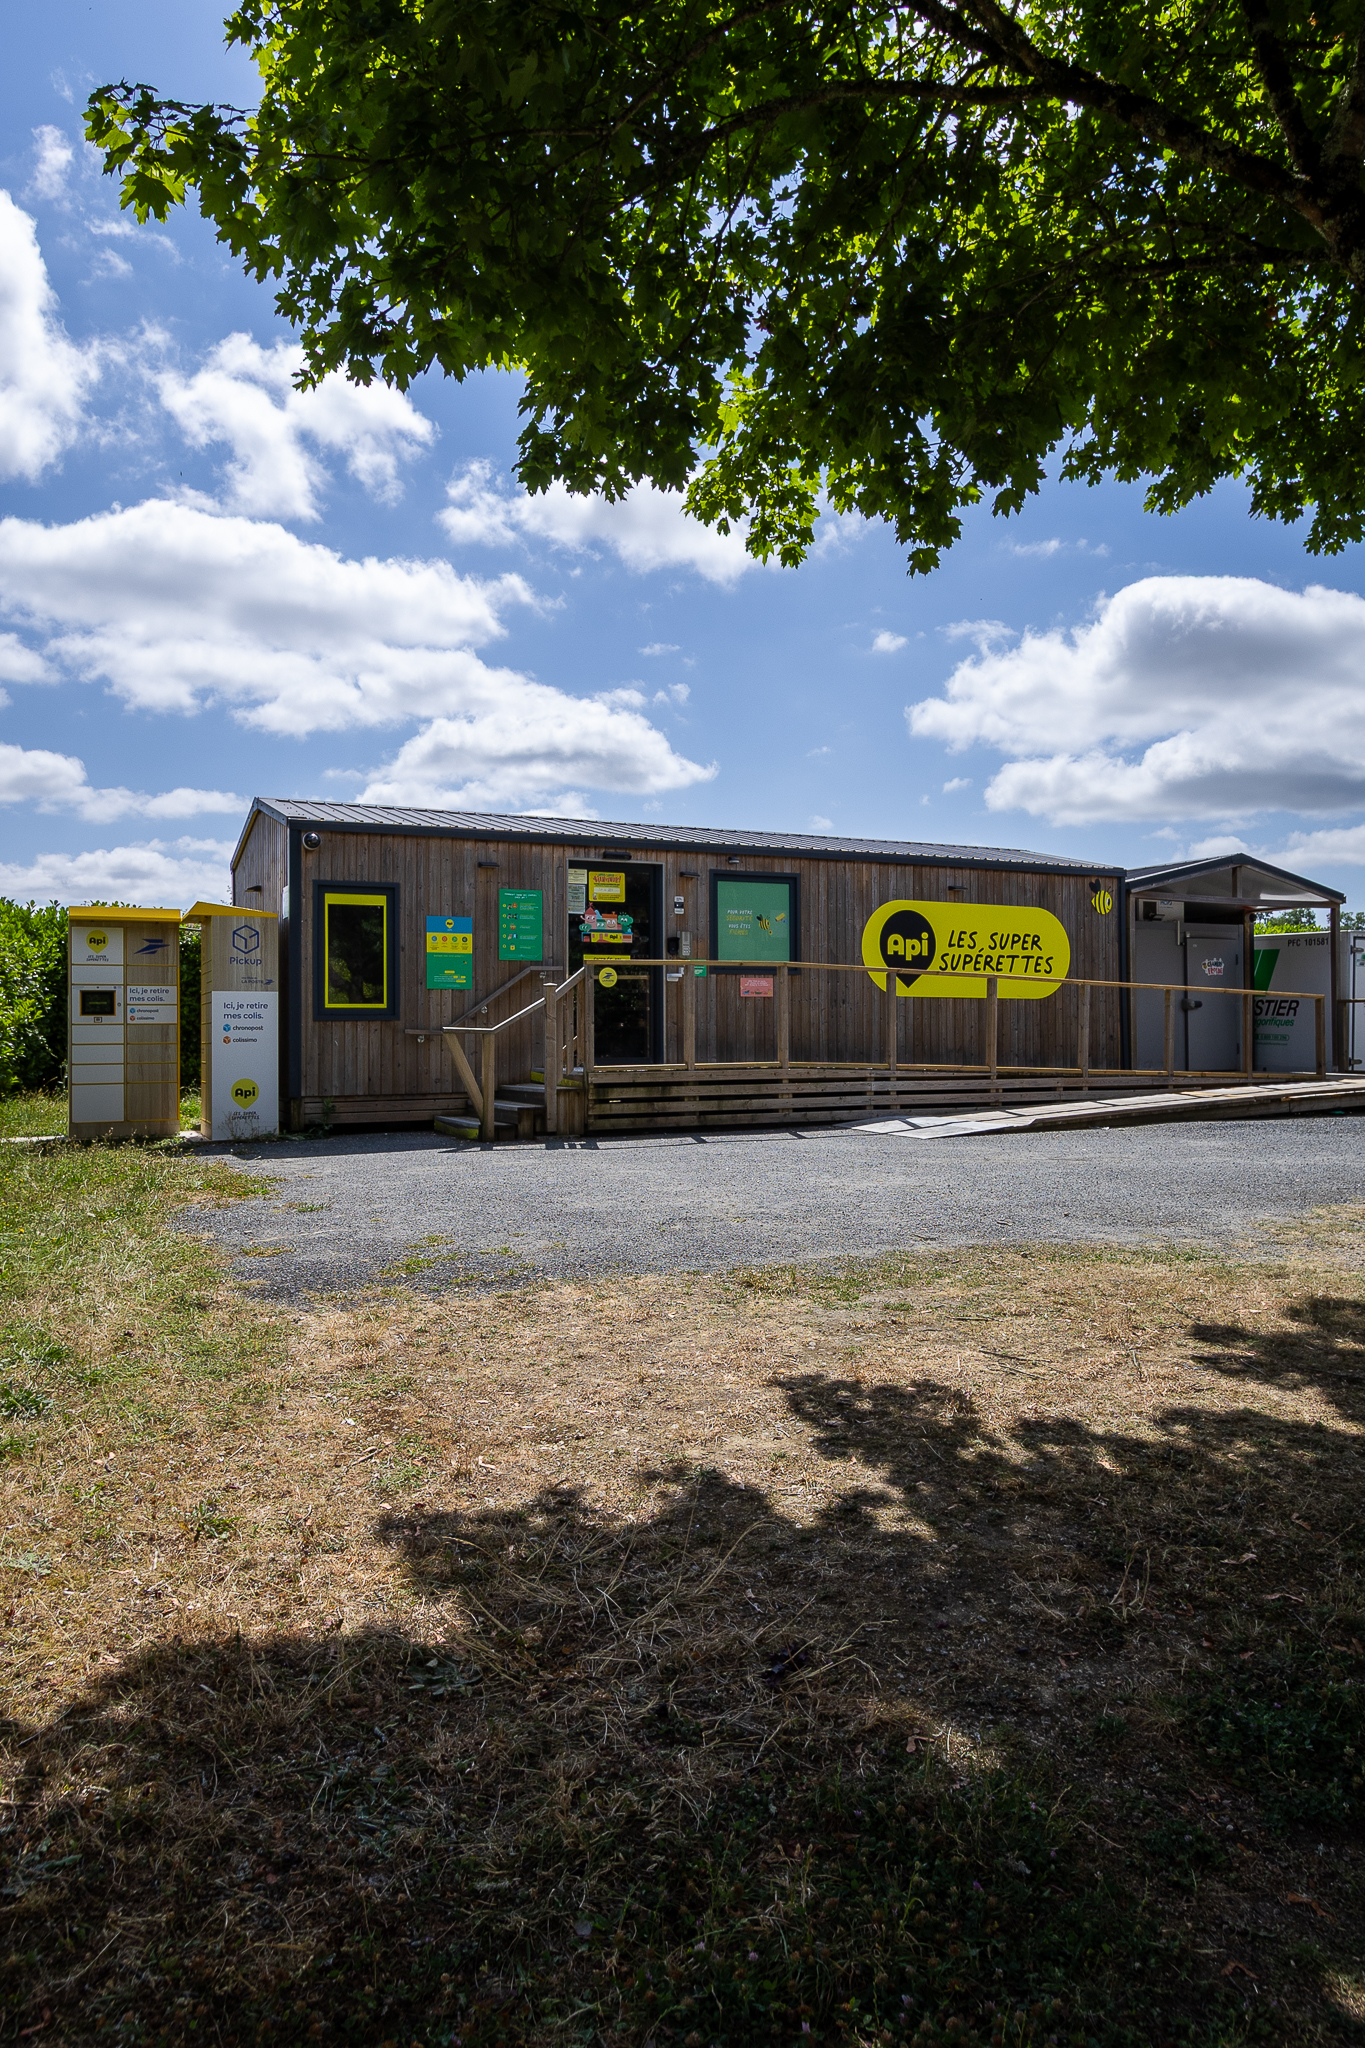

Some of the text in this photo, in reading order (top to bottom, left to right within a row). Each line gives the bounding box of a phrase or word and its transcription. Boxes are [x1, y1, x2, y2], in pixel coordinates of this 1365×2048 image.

[89, 937, 106, 945] Api
[888, 932, 928, 961] Api
[948, 930, 1043, 951] LES SUPER
[1288, 938, 1329, 947] PFC 101581
[229, 956, 262, 966] Pickup
[939, 948, 1054, 974] SUPÉRETTES
[223, 1002, 235, 1010] Ici,
[236, 1002, 244, 1011] je
[1254, 999, 1300, 1016] STIER
[235, 1087, 256, 1099] Api
